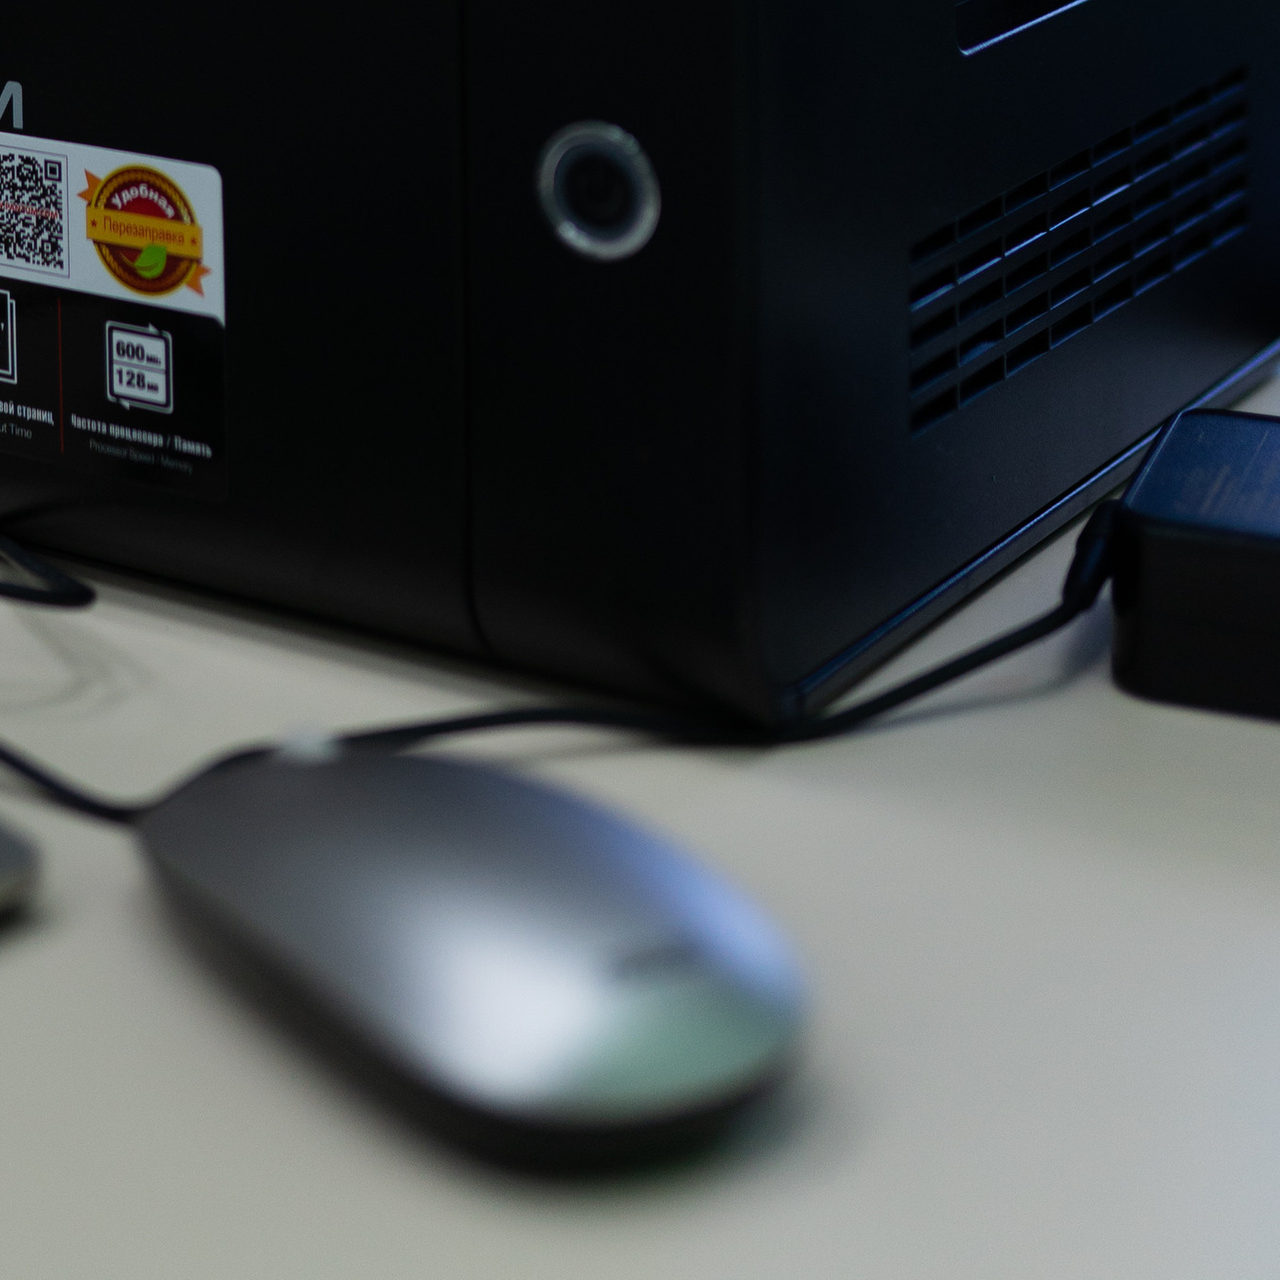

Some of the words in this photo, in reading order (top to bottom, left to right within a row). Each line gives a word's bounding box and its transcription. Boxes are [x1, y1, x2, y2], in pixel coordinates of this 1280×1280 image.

[110, 182, 175, 219] Удобная
[103, 215, 185, 244] Перезаправка
[116, 341, 145, 362] 600
[116, 369, 146, 389] 128
[16, 404, 55, 427] страниц
[9, 423, 33, 440] Time
[71, 412, 108, 436] Частота
[109, 422, 164, 448] процессора
[173, 434, 213, 459] Память
